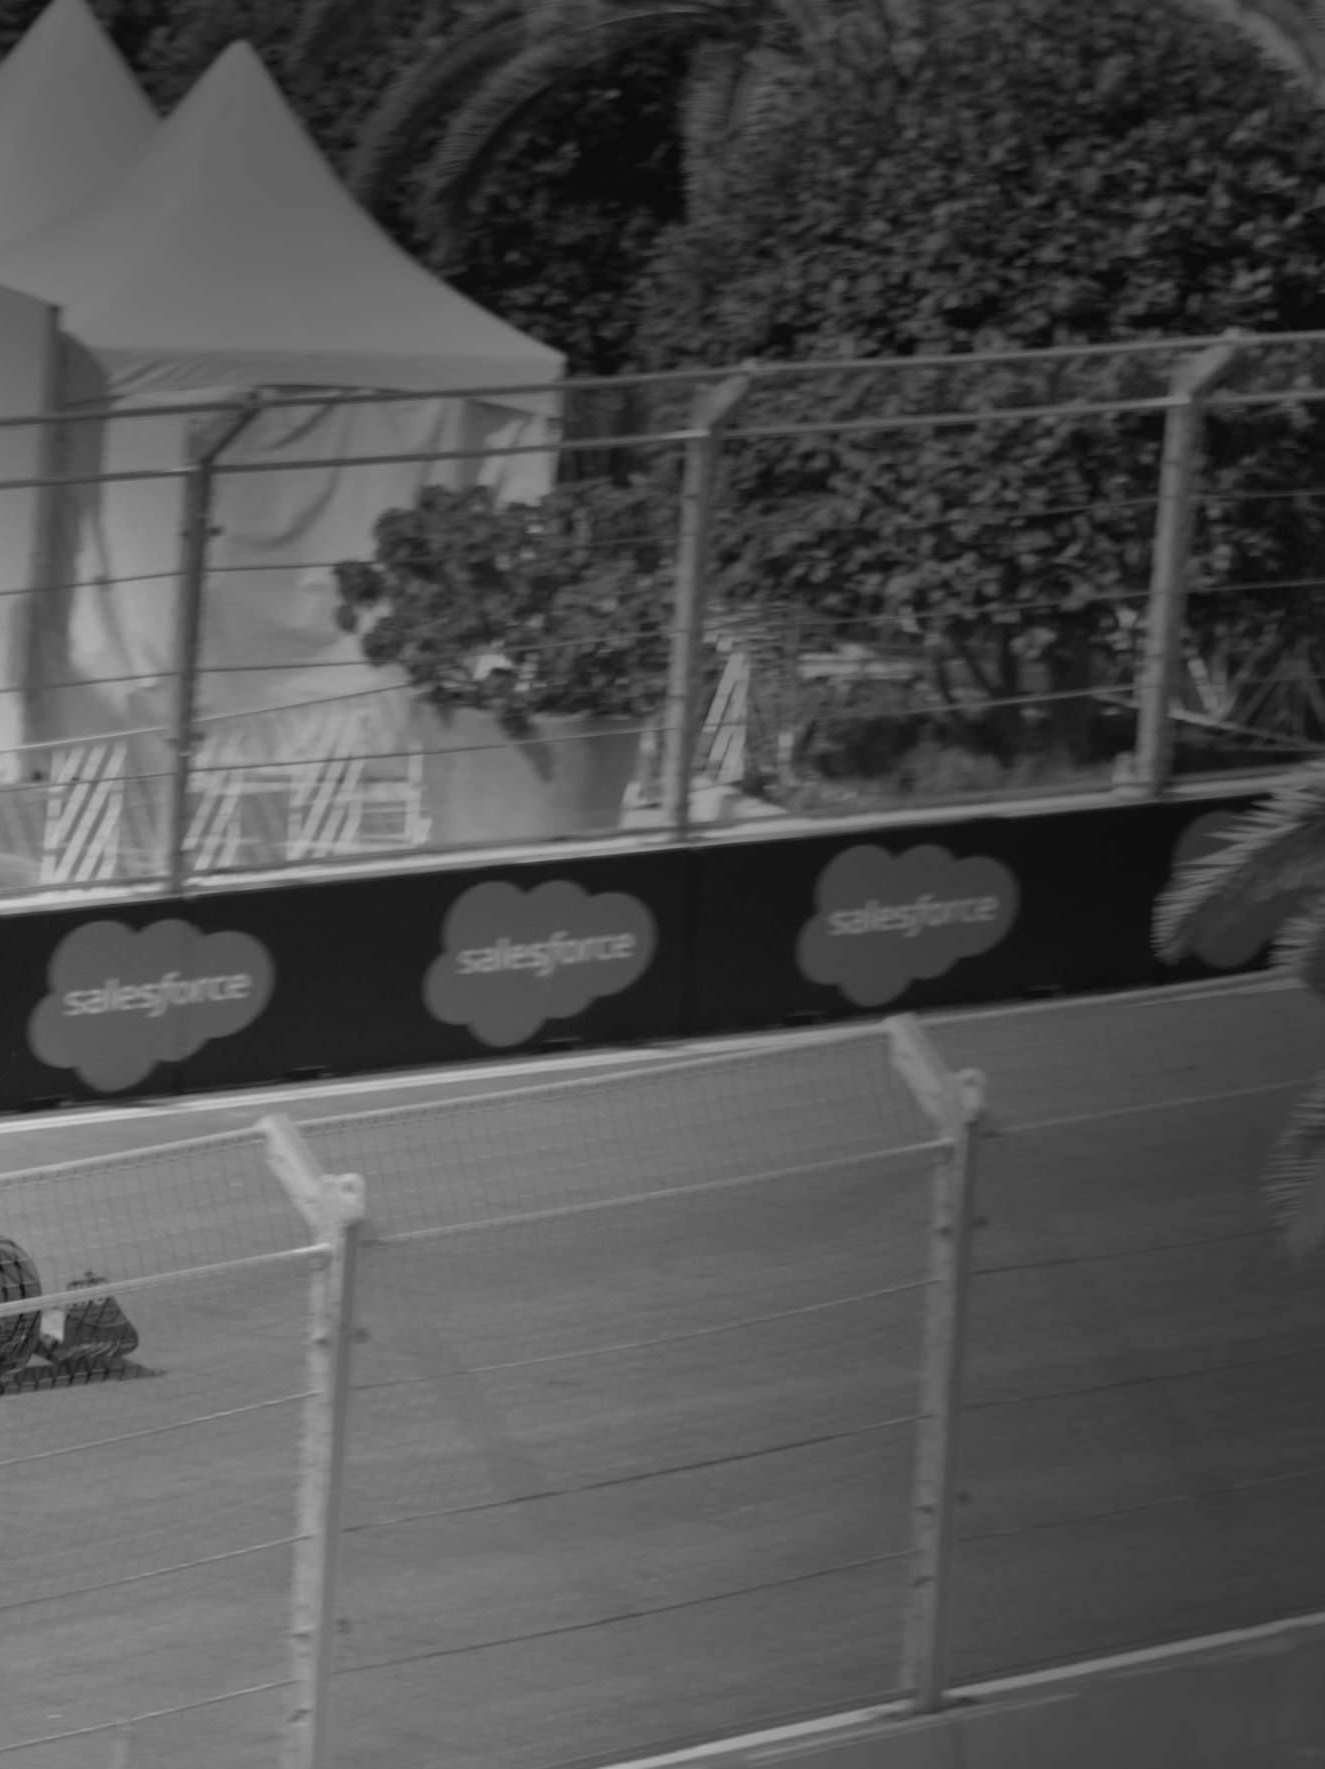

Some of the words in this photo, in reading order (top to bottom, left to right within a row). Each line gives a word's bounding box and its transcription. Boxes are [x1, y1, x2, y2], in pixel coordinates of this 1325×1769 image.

[825, 894, 999, 938] salesforce
[455, 931, 636, 977] salesforce
[61, 972, 252, 1019] salesforce
